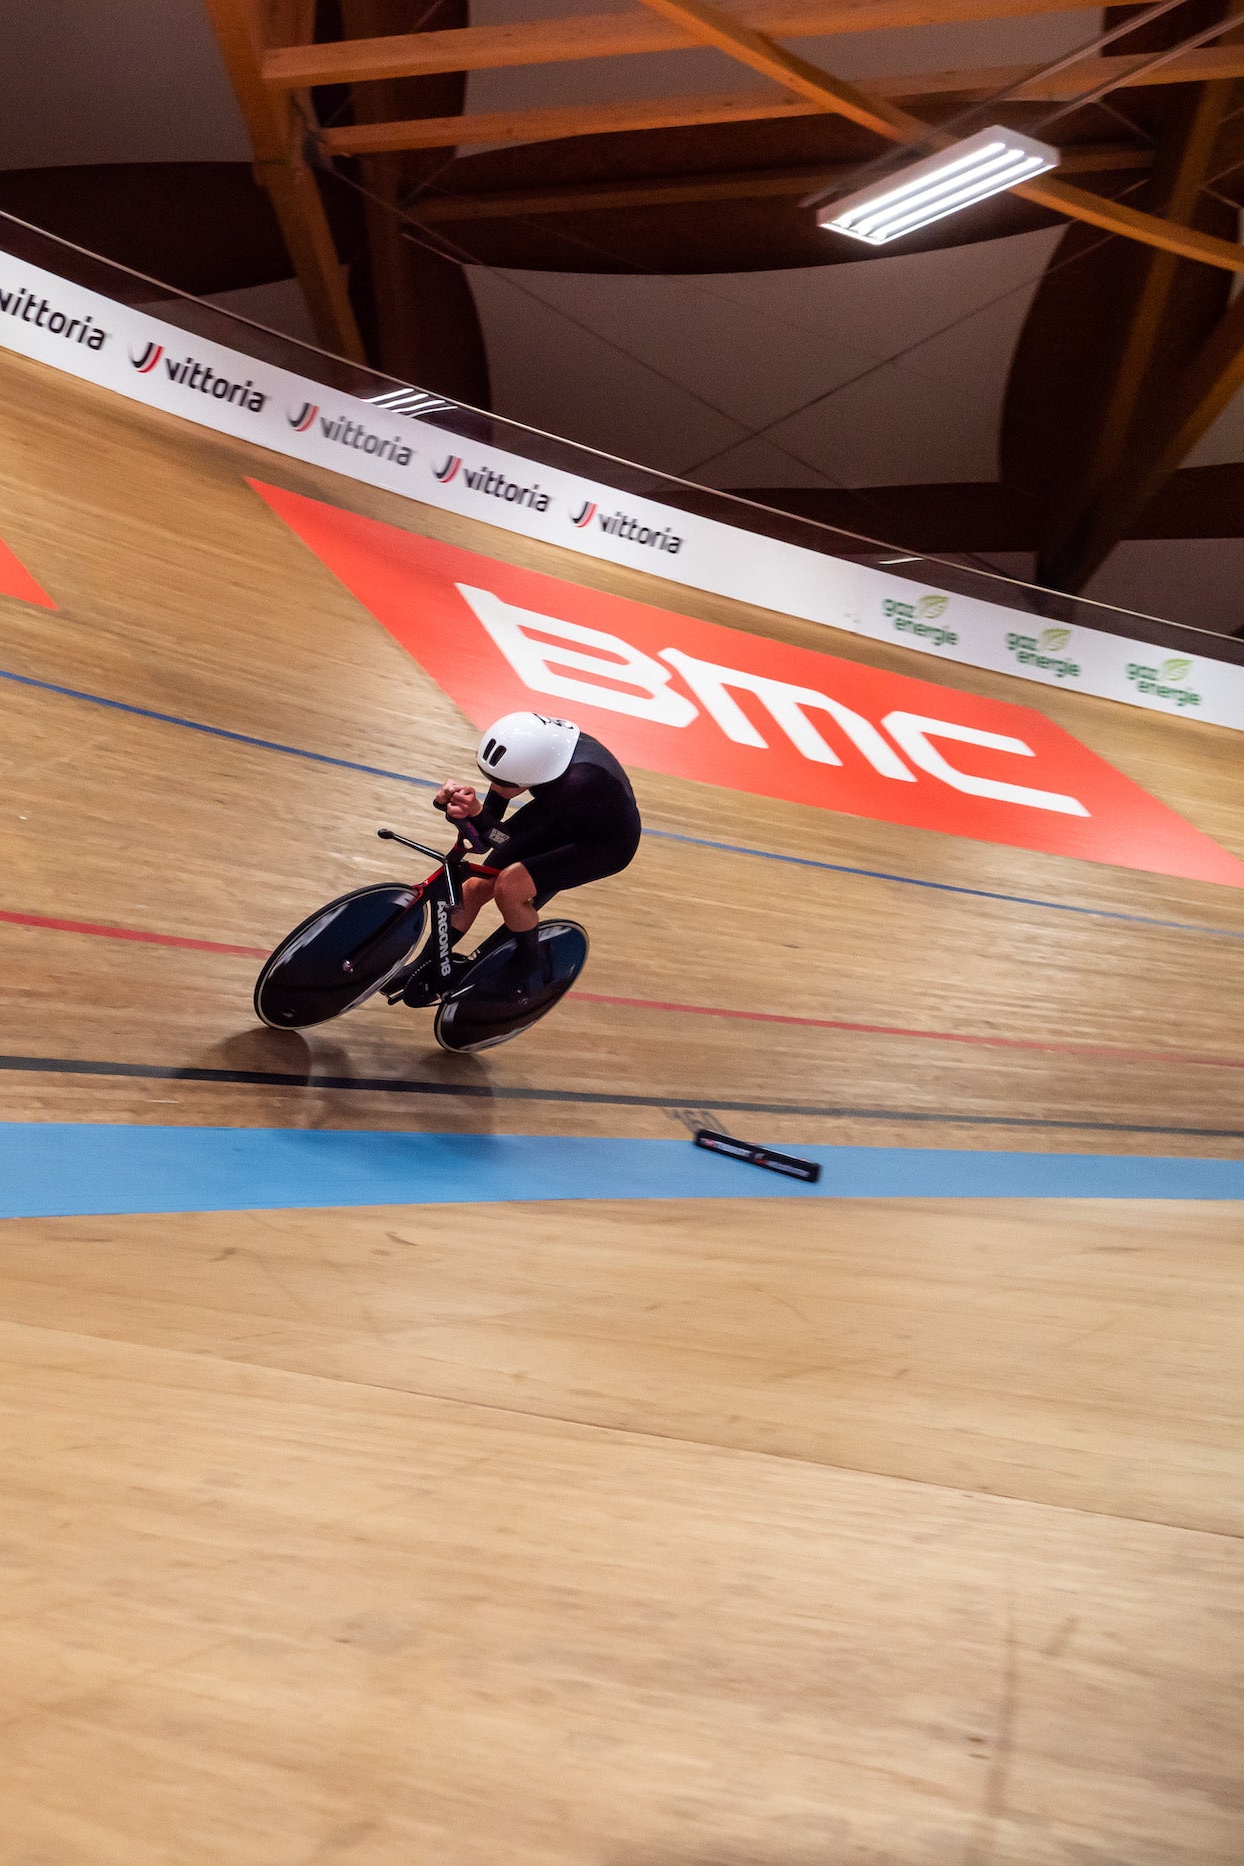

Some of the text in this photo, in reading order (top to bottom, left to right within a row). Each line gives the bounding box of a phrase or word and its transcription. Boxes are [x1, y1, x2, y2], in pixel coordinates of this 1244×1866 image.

[166, 357, 266, 412] vittoria
[320, 416, 413, 466] vittoria
[463, 466, 549, 512] vittoria
[599, 511, 682, 554] vittoria
[894, 617, 959, 646] energie
[1017, 650, 1080, 678] energie
[455, 582, 1091, 817] BMC
[1137, 681, 1201, 706] energie
